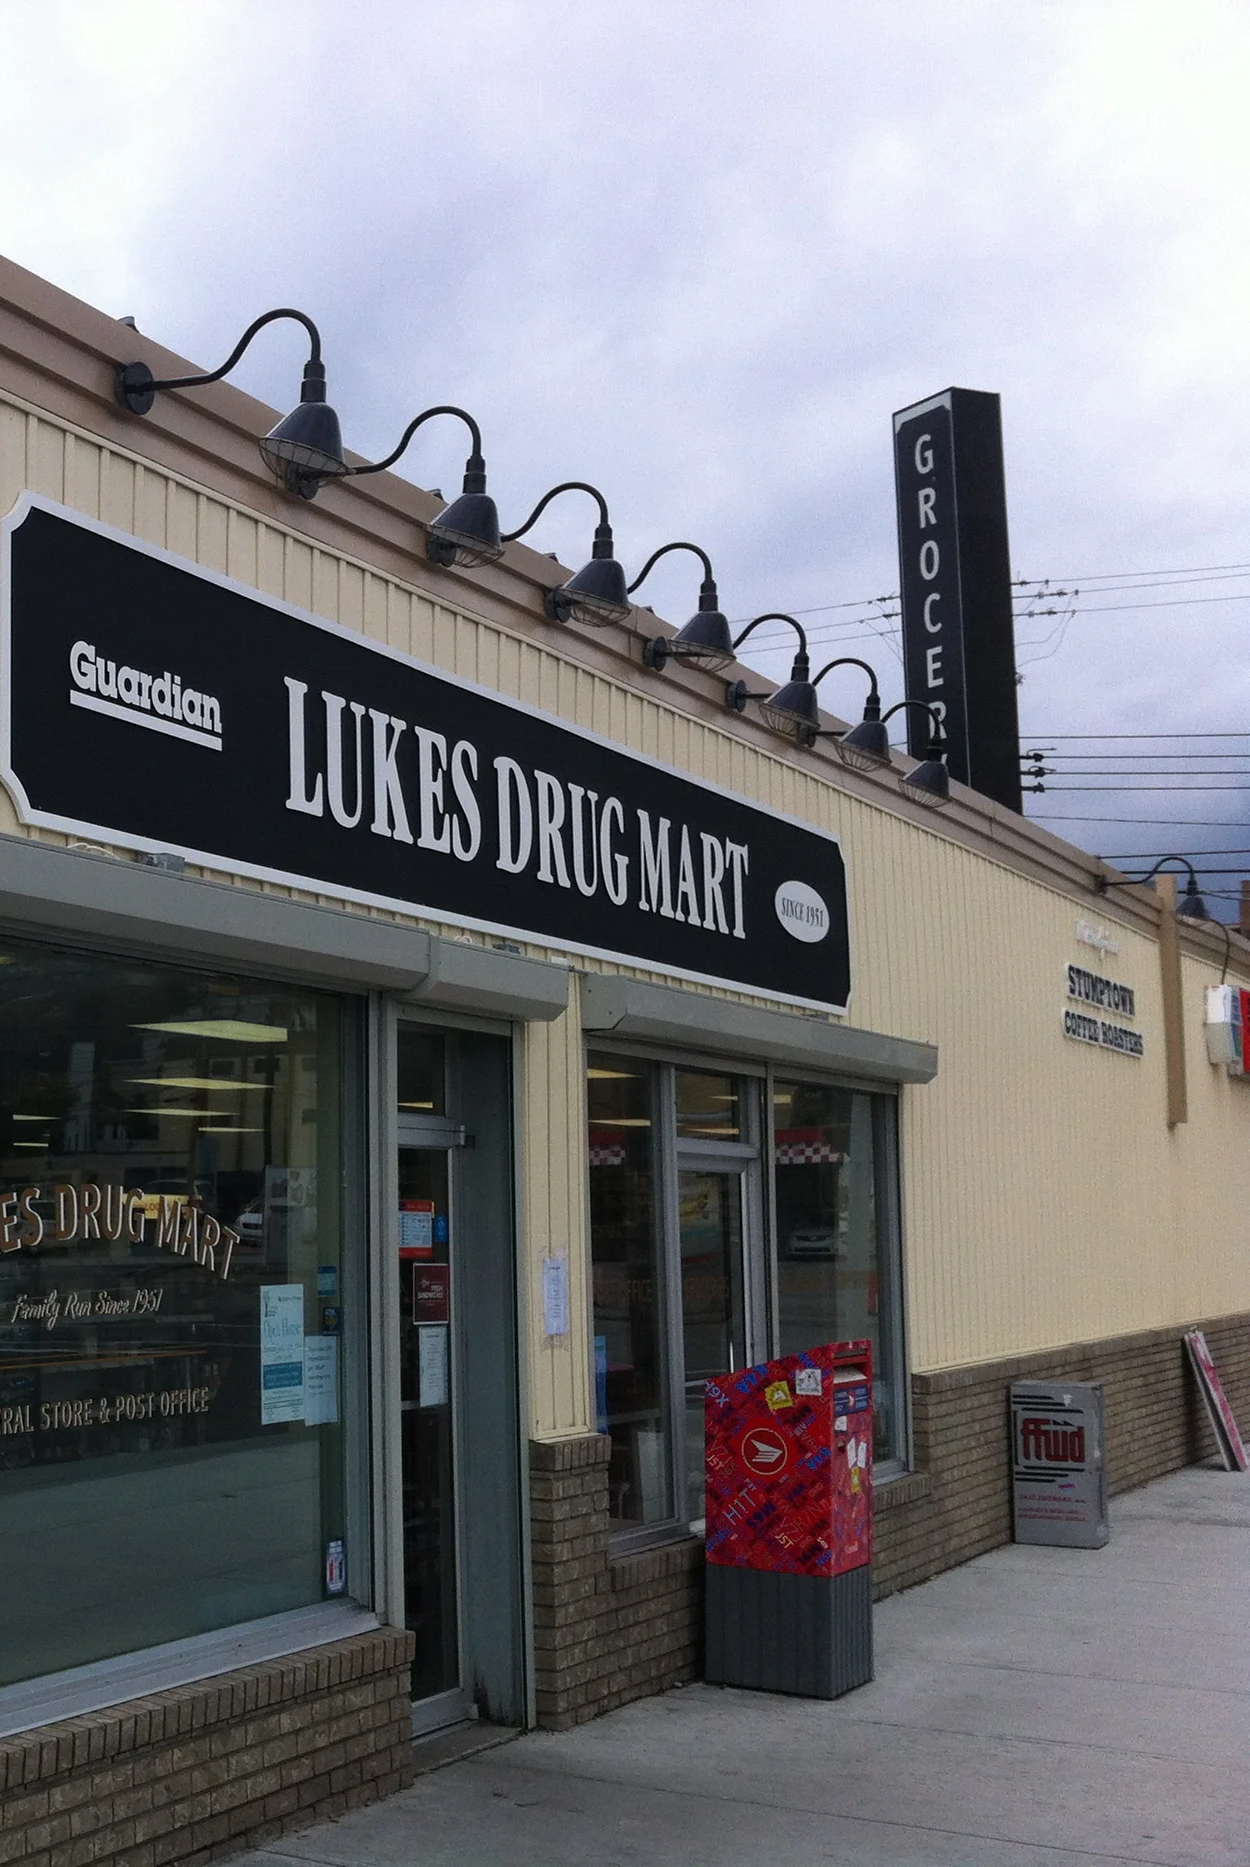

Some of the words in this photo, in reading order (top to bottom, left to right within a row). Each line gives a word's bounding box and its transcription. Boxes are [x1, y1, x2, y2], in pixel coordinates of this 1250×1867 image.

[914, 433, 949, 765] GROCER
[68, 639, 223, 735] Guardian
[283, 675, 483, 863] LUKES
[492, 755, 629, 907] DRUG
[636, 807, 750, 940] MART
[781, 897, 804, 922] SINCE
[805, 905, 824, 928] 1951
[1068, 964, 1135, 1017] STUMPTOWN
[1064, 1010, 1099, 1043] COFFEE
[55, 1182, 145, 1243] DRUG
[155, 1194, 241, 1280] MART
[10, 1288, 61, 1332] Family
[63, 1291, 92, 1320] Run
[95, 1290, 131, 1315] Since
[133, 1287, 164, 1314] 1951
[40, 1397, 94, 1430] STORE
[98, 1396, 111, 1424] &
[115, 1392, 155, 1421] POST
[159, 1387, 209, 1417] OFFICE
